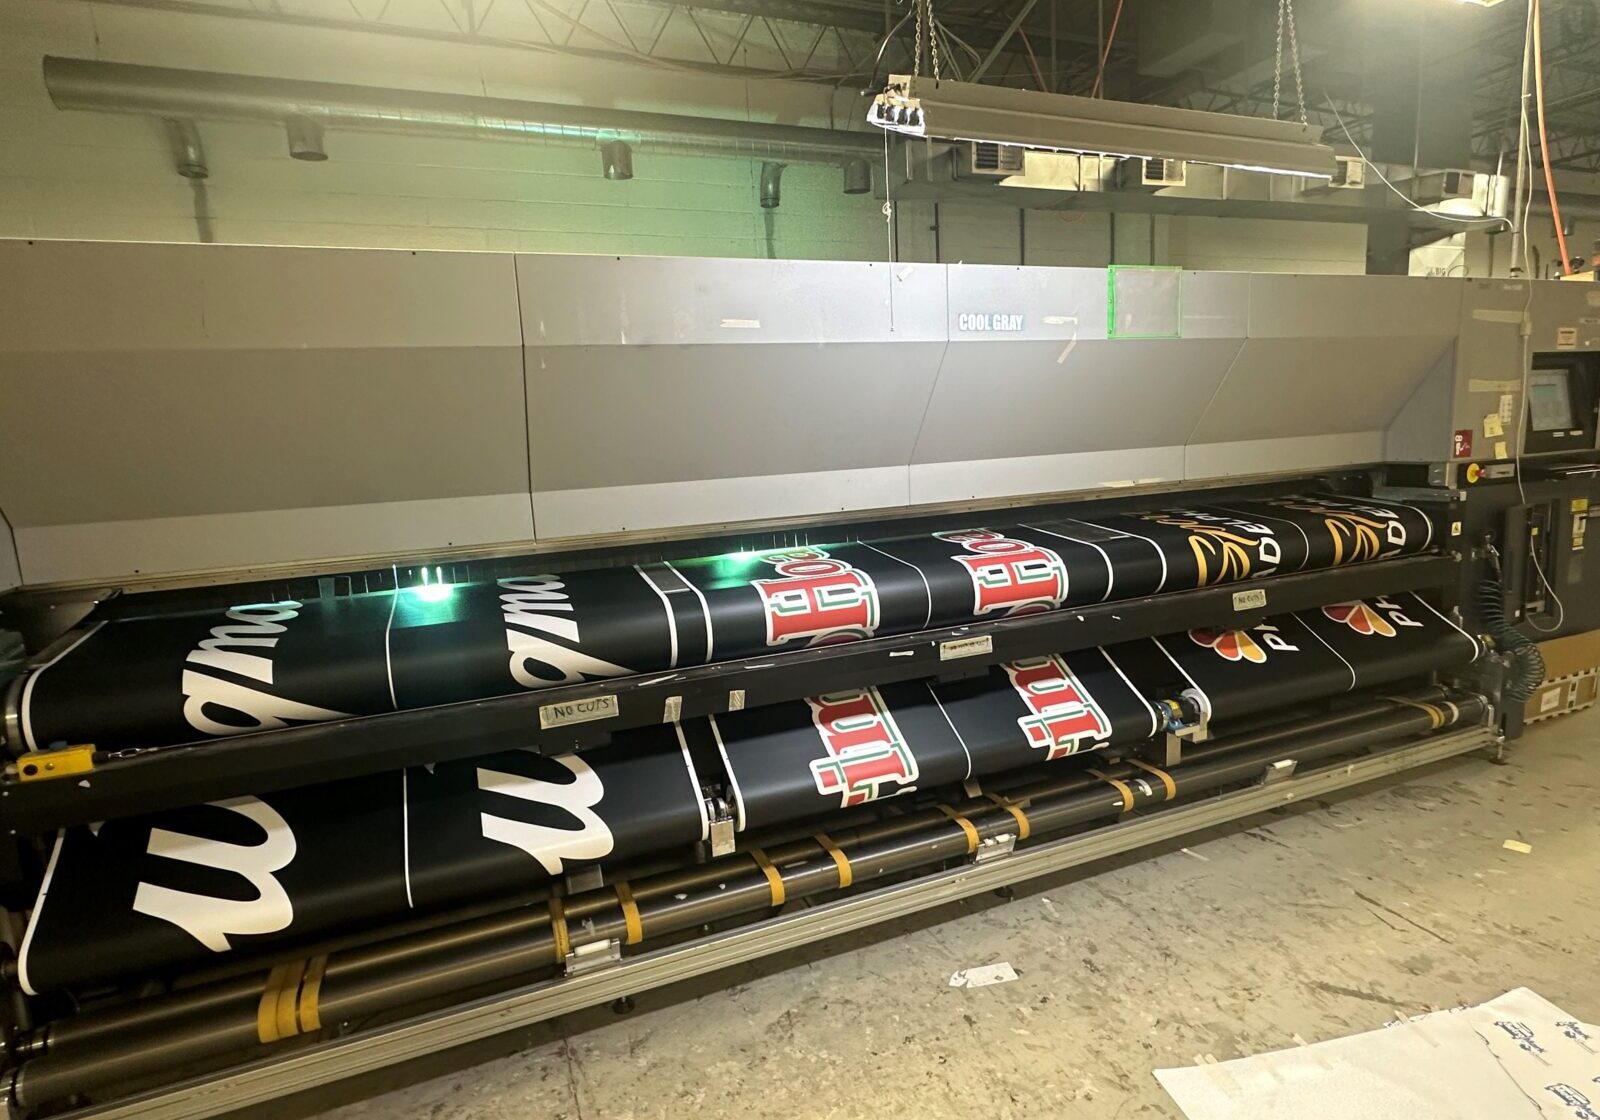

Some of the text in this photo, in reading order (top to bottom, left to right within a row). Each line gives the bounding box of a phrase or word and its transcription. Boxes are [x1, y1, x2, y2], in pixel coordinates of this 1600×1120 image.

[959, 313, 1023, 331] COOL GRAY
[553, 698, 609, 719] NO CUTS
